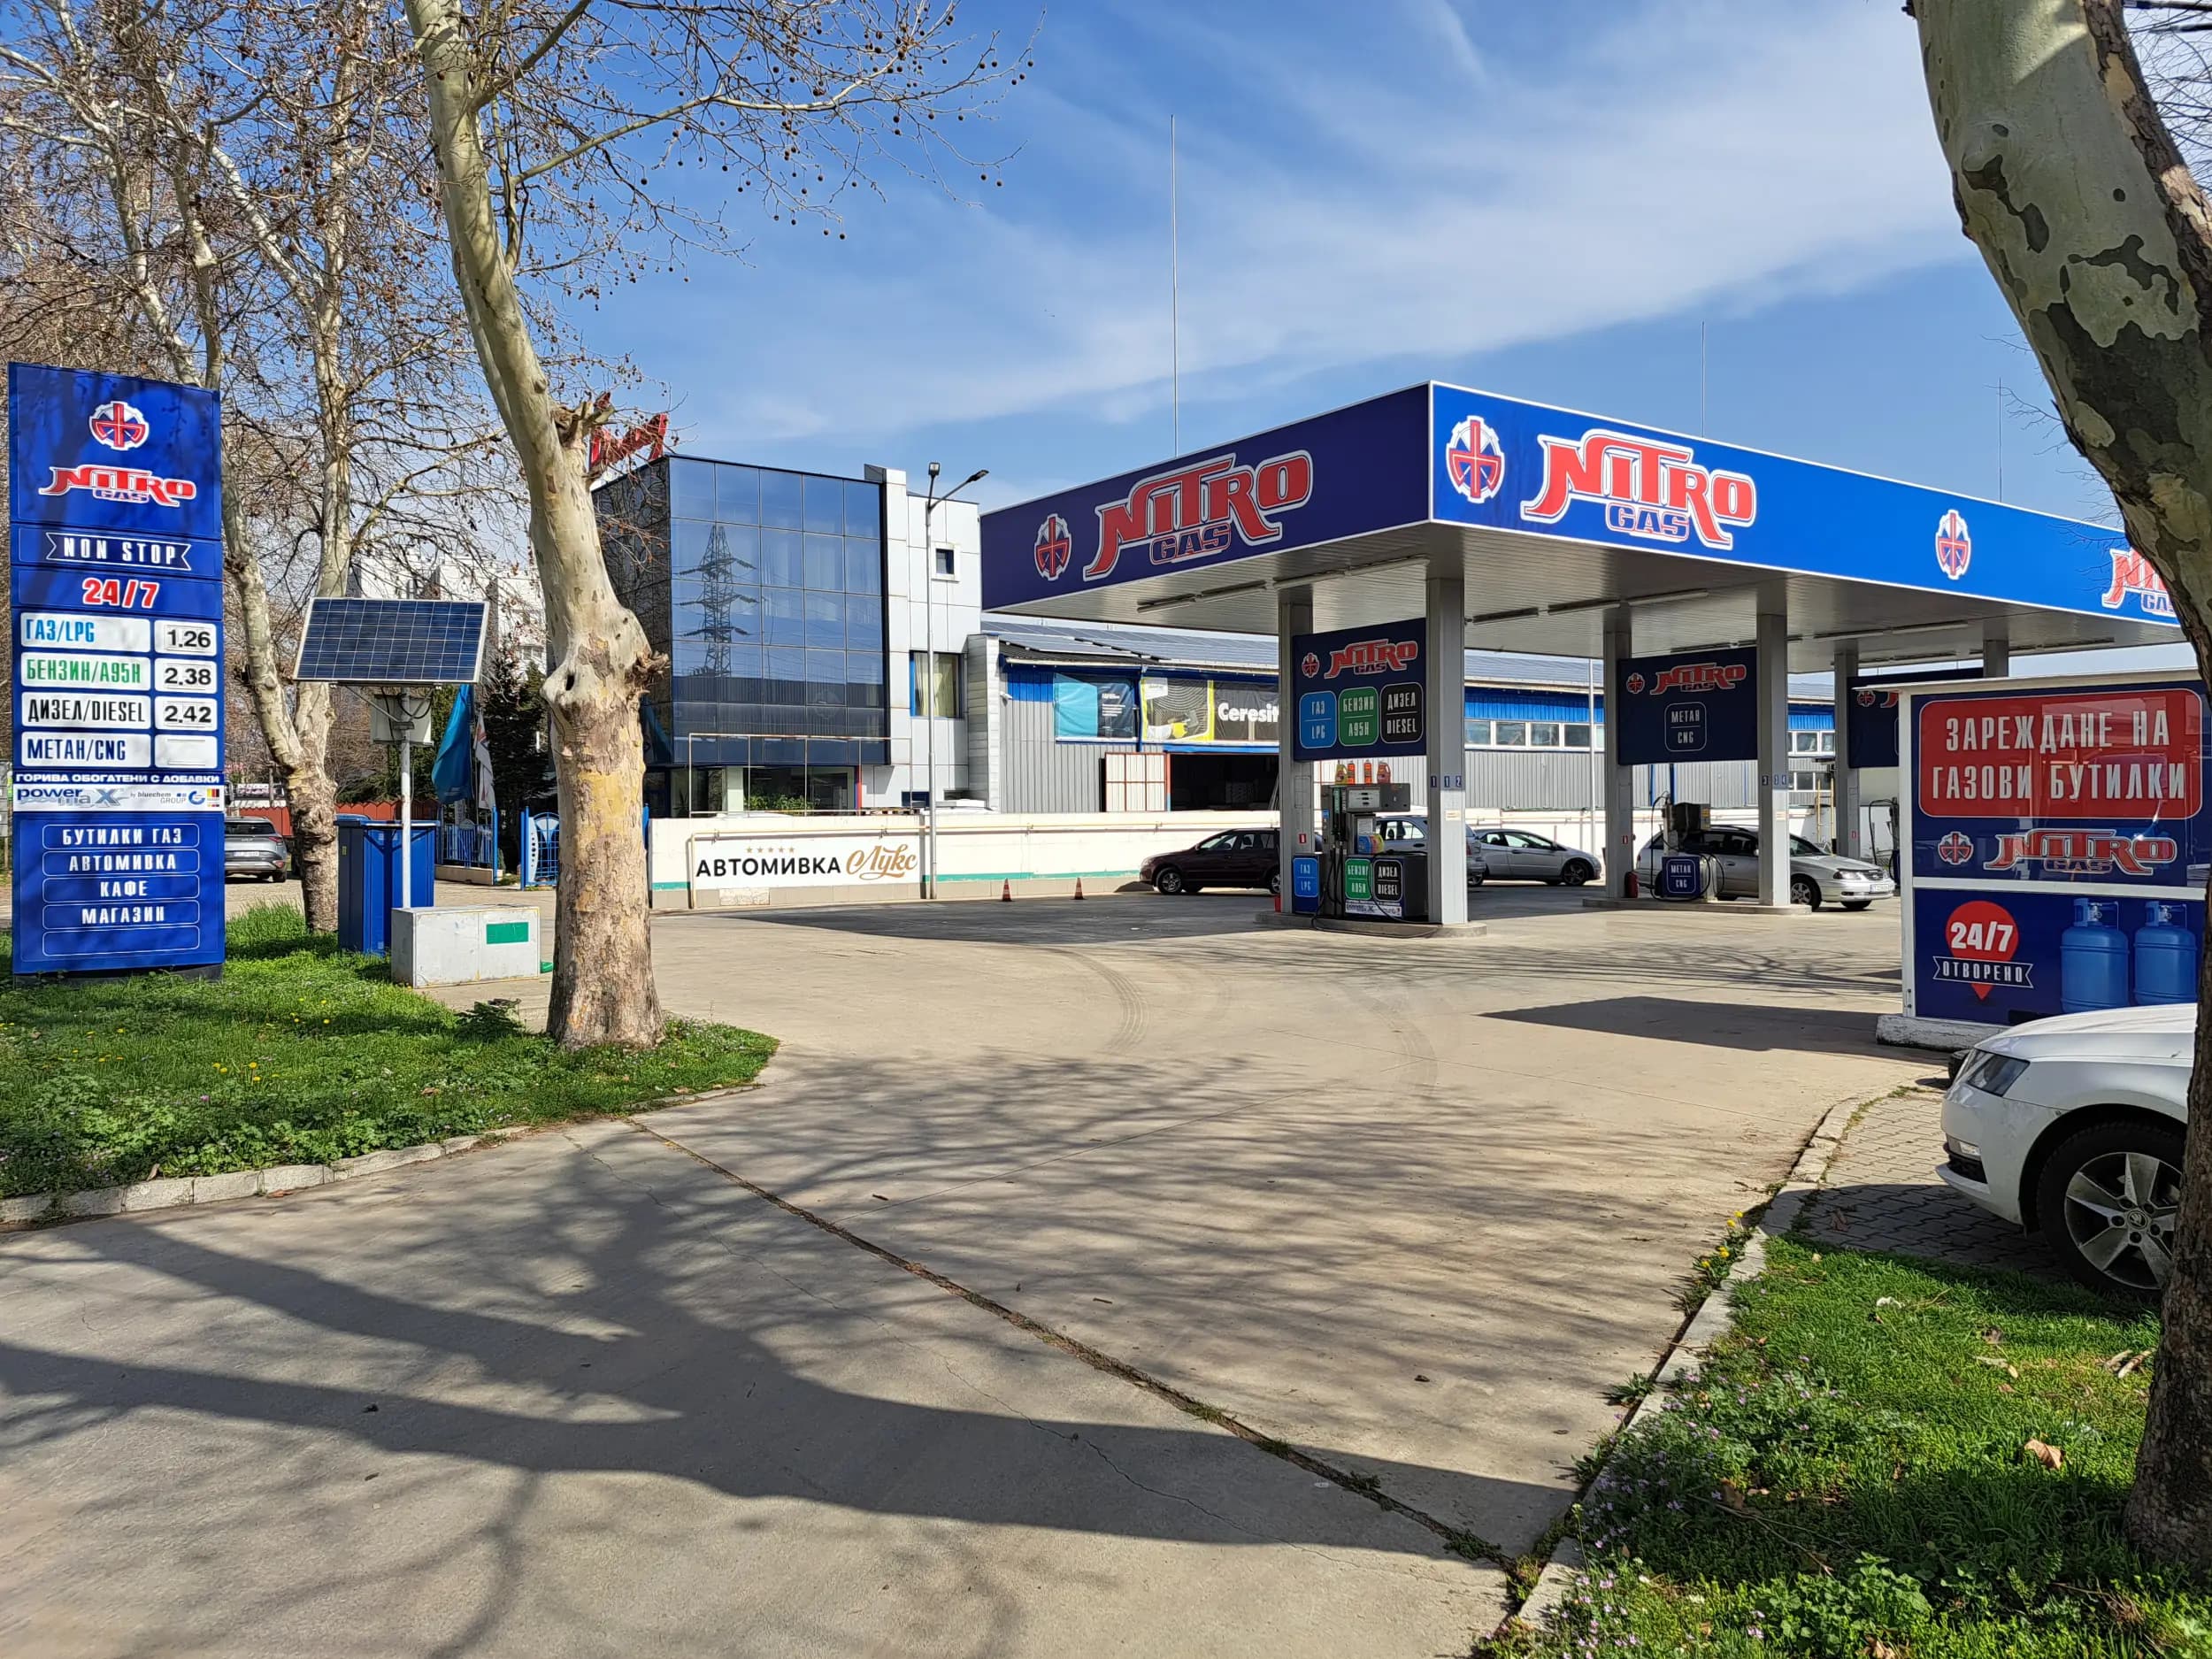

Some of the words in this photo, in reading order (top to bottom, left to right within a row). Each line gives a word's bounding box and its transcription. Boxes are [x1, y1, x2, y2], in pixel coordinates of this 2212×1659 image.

[39, 465, 196, 508] NITRO
[93, 489, 149, 503] GAS
[1520, 427, 1756, 550] NITRO
[1082, 449, 1313, 582] NITRO
[1607, 502, 1691, 541] GAS
[63, 537, 107, 560] NON
[123, 540, 175, 565] STOP
[1150, 521, 1232, 566] GAS
[82, 578, 159, 608] 24/7
[26, 619, 95, 642] ГАЗ/LPG
[167, 629, 211, 648] 1.26
[1324, 638, 1418, 680] NITRO
[164, 667, 211, 686] 2.38
[1354, 663, 1386, 675] GAS
[1649, 662, 1747, 695] NITRO
[1311, 700, 1325, 715] ГАЗ
[1343, 695, 1374, 712] БЕНЗИН
[1387, 691, 1417, 710] ДИЗЕЛ
[27, 699, 145, 722] ДИЗЕЛ/DIESEL
[164, 706, 211, 724] 2.42
[1217, 703, 1279, 723] Ceresit
[1671, 709, 1700, 723] МЕТАН
[1311, 724, 1325, 740] LPG
[1386, 717, 1417, 734] DIESEL
[1946, 711, 2113, 754] ЗАРЕЖДАНЕ
[2132, 710, 2170, 747] НА
[1678, 732, 1694, 744] CNG
[27, 739, 126, 761] МЕТАН/CNG
[16, 773, 69, 782] ГОРИВА
[73, 774, 147, 783] ОБОГАТЕНИ
[163, 775, 219, 784] ДОБАВКИ
[1932, 765, 2032, 799] ГАЗОВИ
[2050, 763, 2185, 801] БУТИЛКИ
[17, 787, 82, 801] power
[63, 828, 142, 845] БУТИЛКИ
[152, 827, 182, 844] ГАЗ
[1983, 827, 2177, 875] NITRO
[69, 854, 176, 872] АВТОМИВКА
[696, 856, 841, 878] АВТОМИВКА
[845, 843, 918, 880] Лукс
[2043, 858, 2113, 874] GAS
[1379, 866, 1398, 879] ДИЗЕЛ
[100, 880, 149, 897] КАФЕ
[1378, 884, 1398, 895] DIESEL
[81, 906, 165, 925] МАГАЗИН
[1950, 920, 2014, 952] 24/7
[1942, 961, 2024, 983] ОТВОРЕНО
